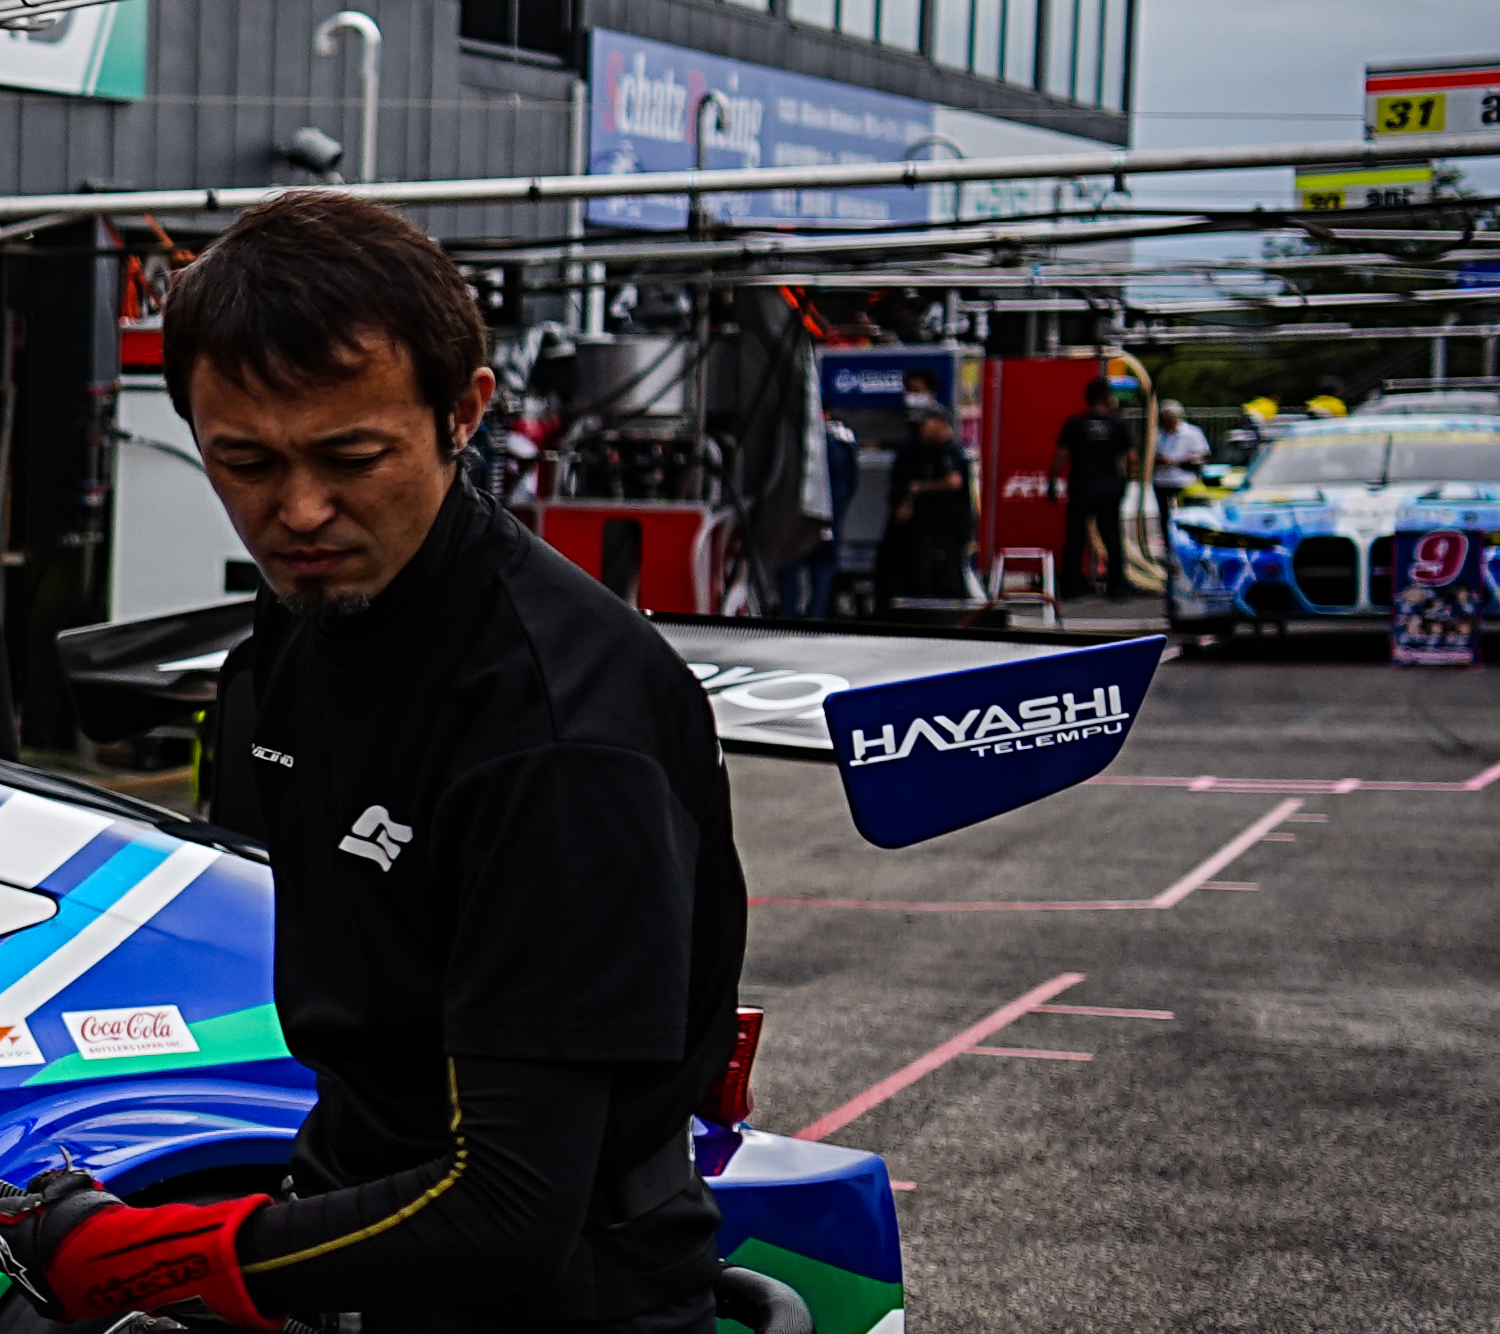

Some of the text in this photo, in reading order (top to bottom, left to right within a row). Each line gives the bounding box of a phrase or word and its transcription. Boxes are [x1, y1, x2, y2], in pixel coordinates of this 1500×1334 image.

[1385, 98, 1435, 130] 31
[1407, 529, 1470, 588] 9
[852, 685, 1122, 759] HAYASHI
[971, 722, 1123, 758] TELEMPU
[80, 1011, 175, 1044] Coca-Cola
